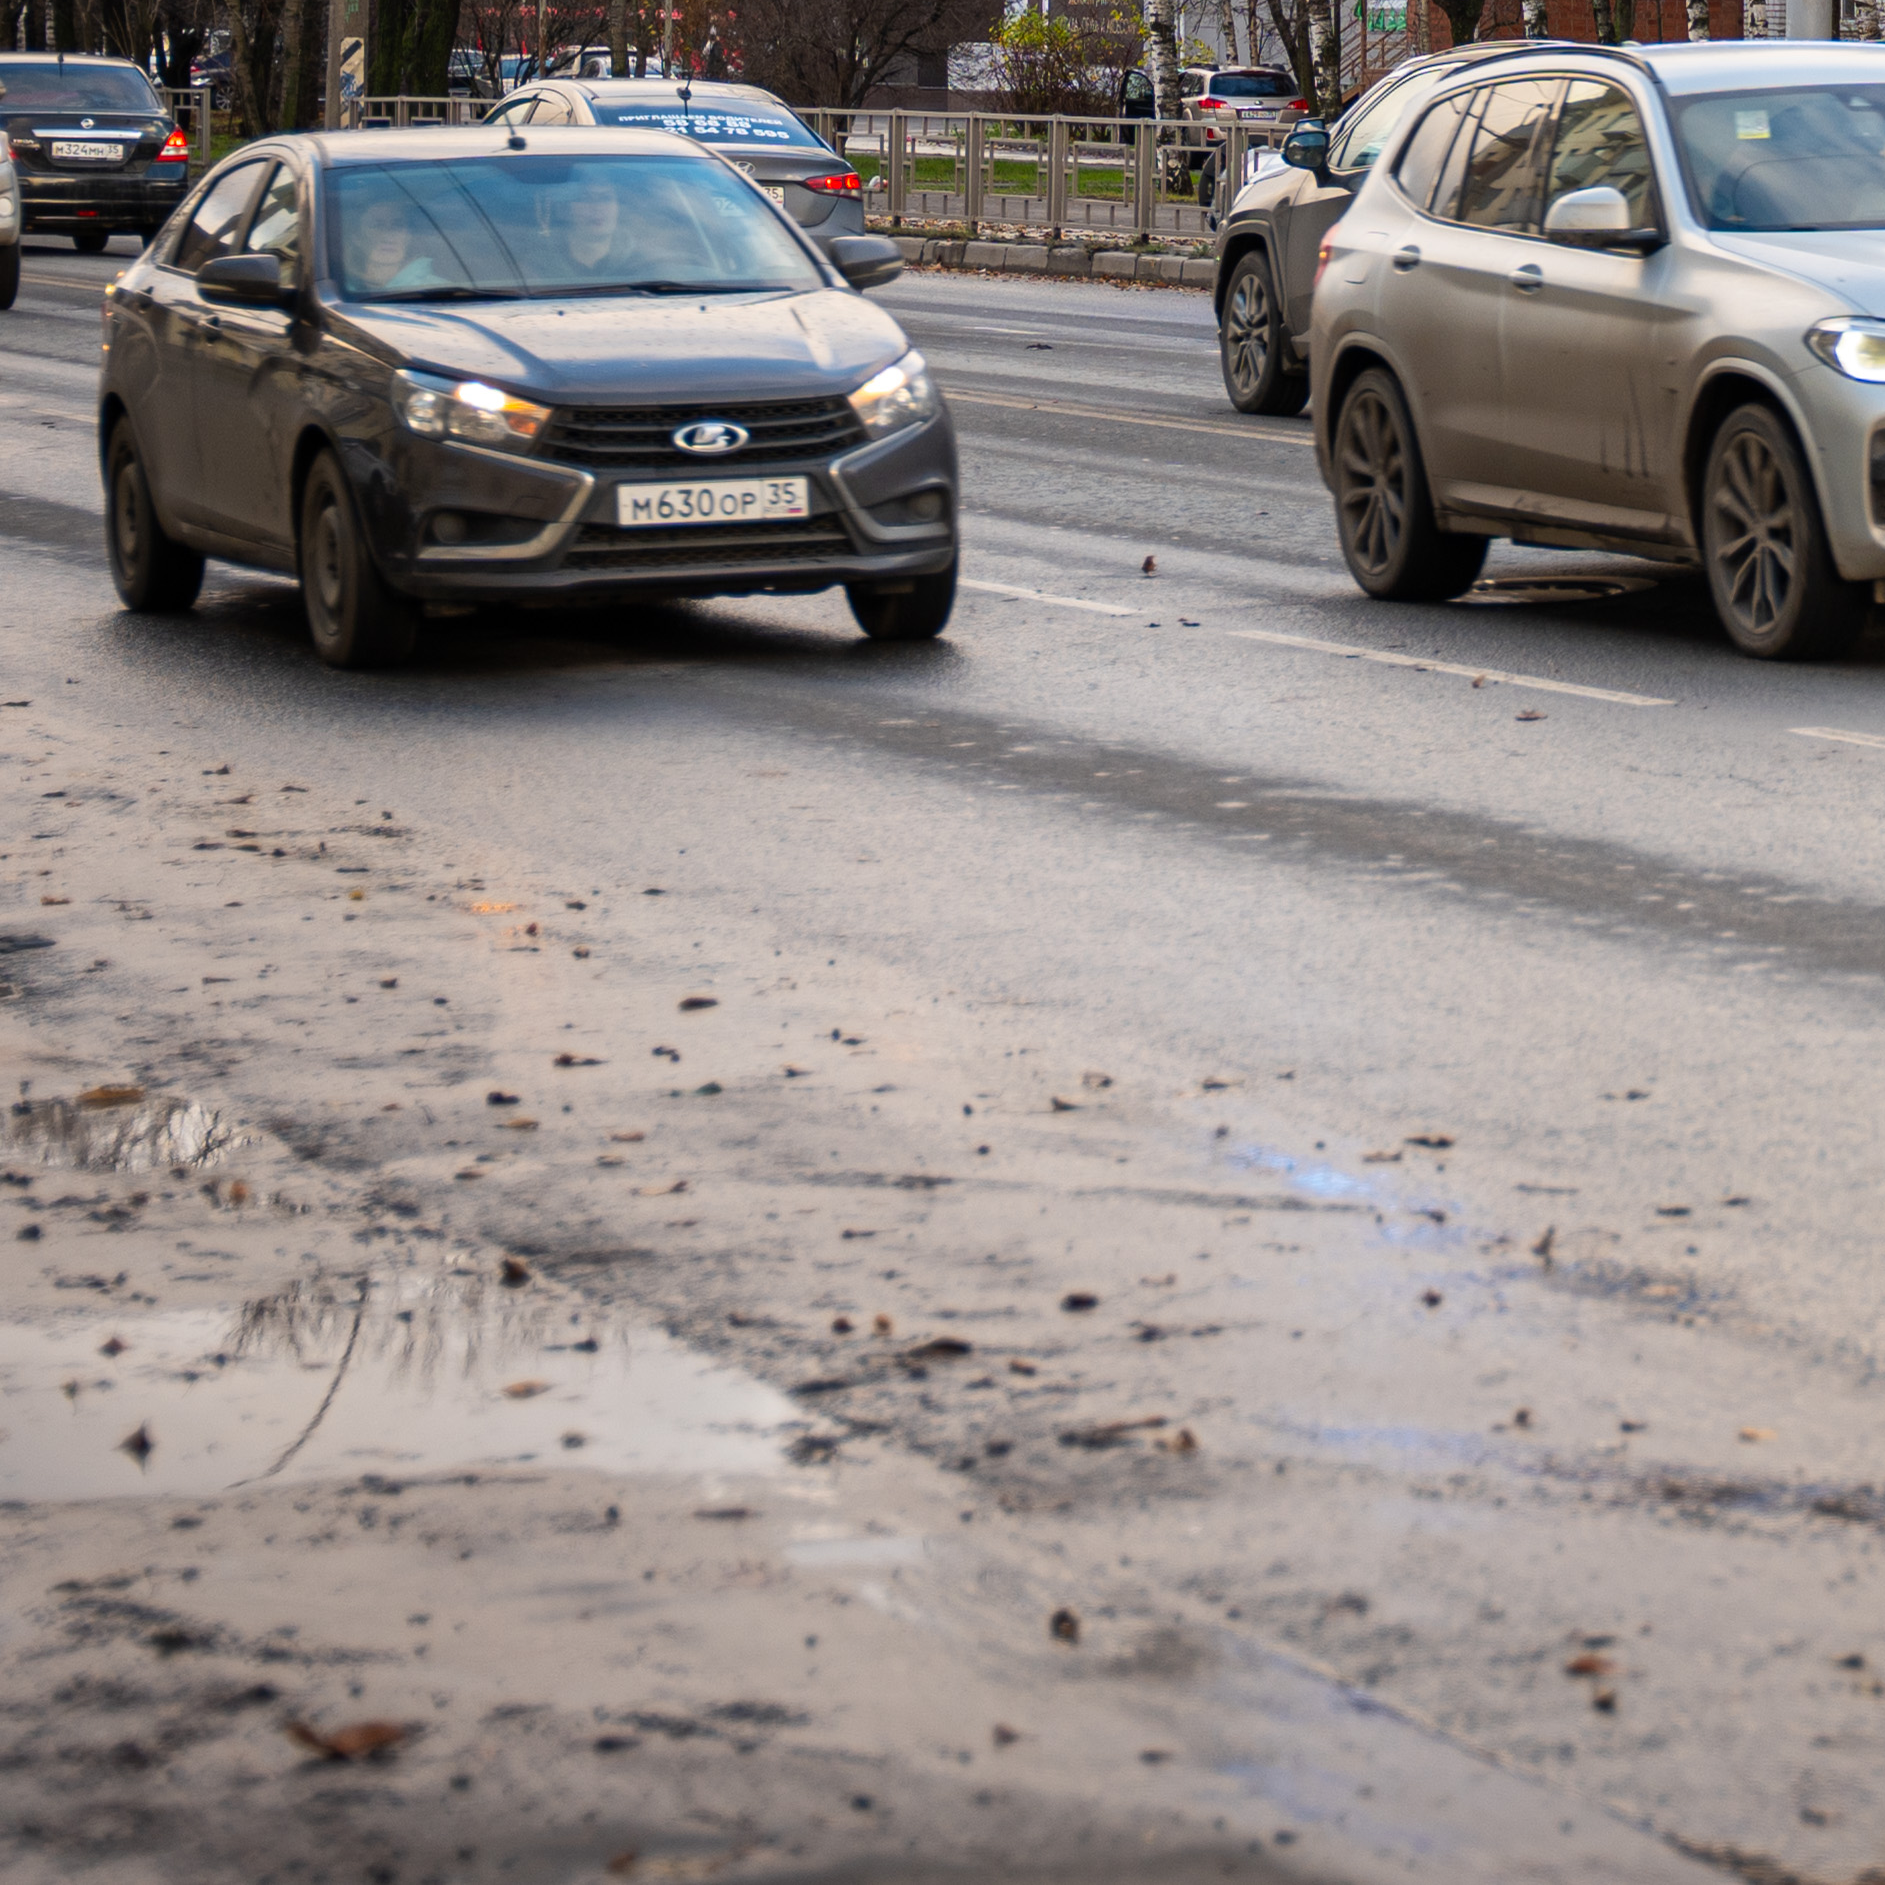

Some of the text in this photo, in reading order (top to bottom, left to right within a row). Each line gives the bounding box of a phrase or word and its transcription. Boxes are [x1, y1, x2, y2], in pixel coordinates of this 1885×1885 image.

[108, 145, 119, 154] 35
[631, 482, 797, 520] М630ОР 35
